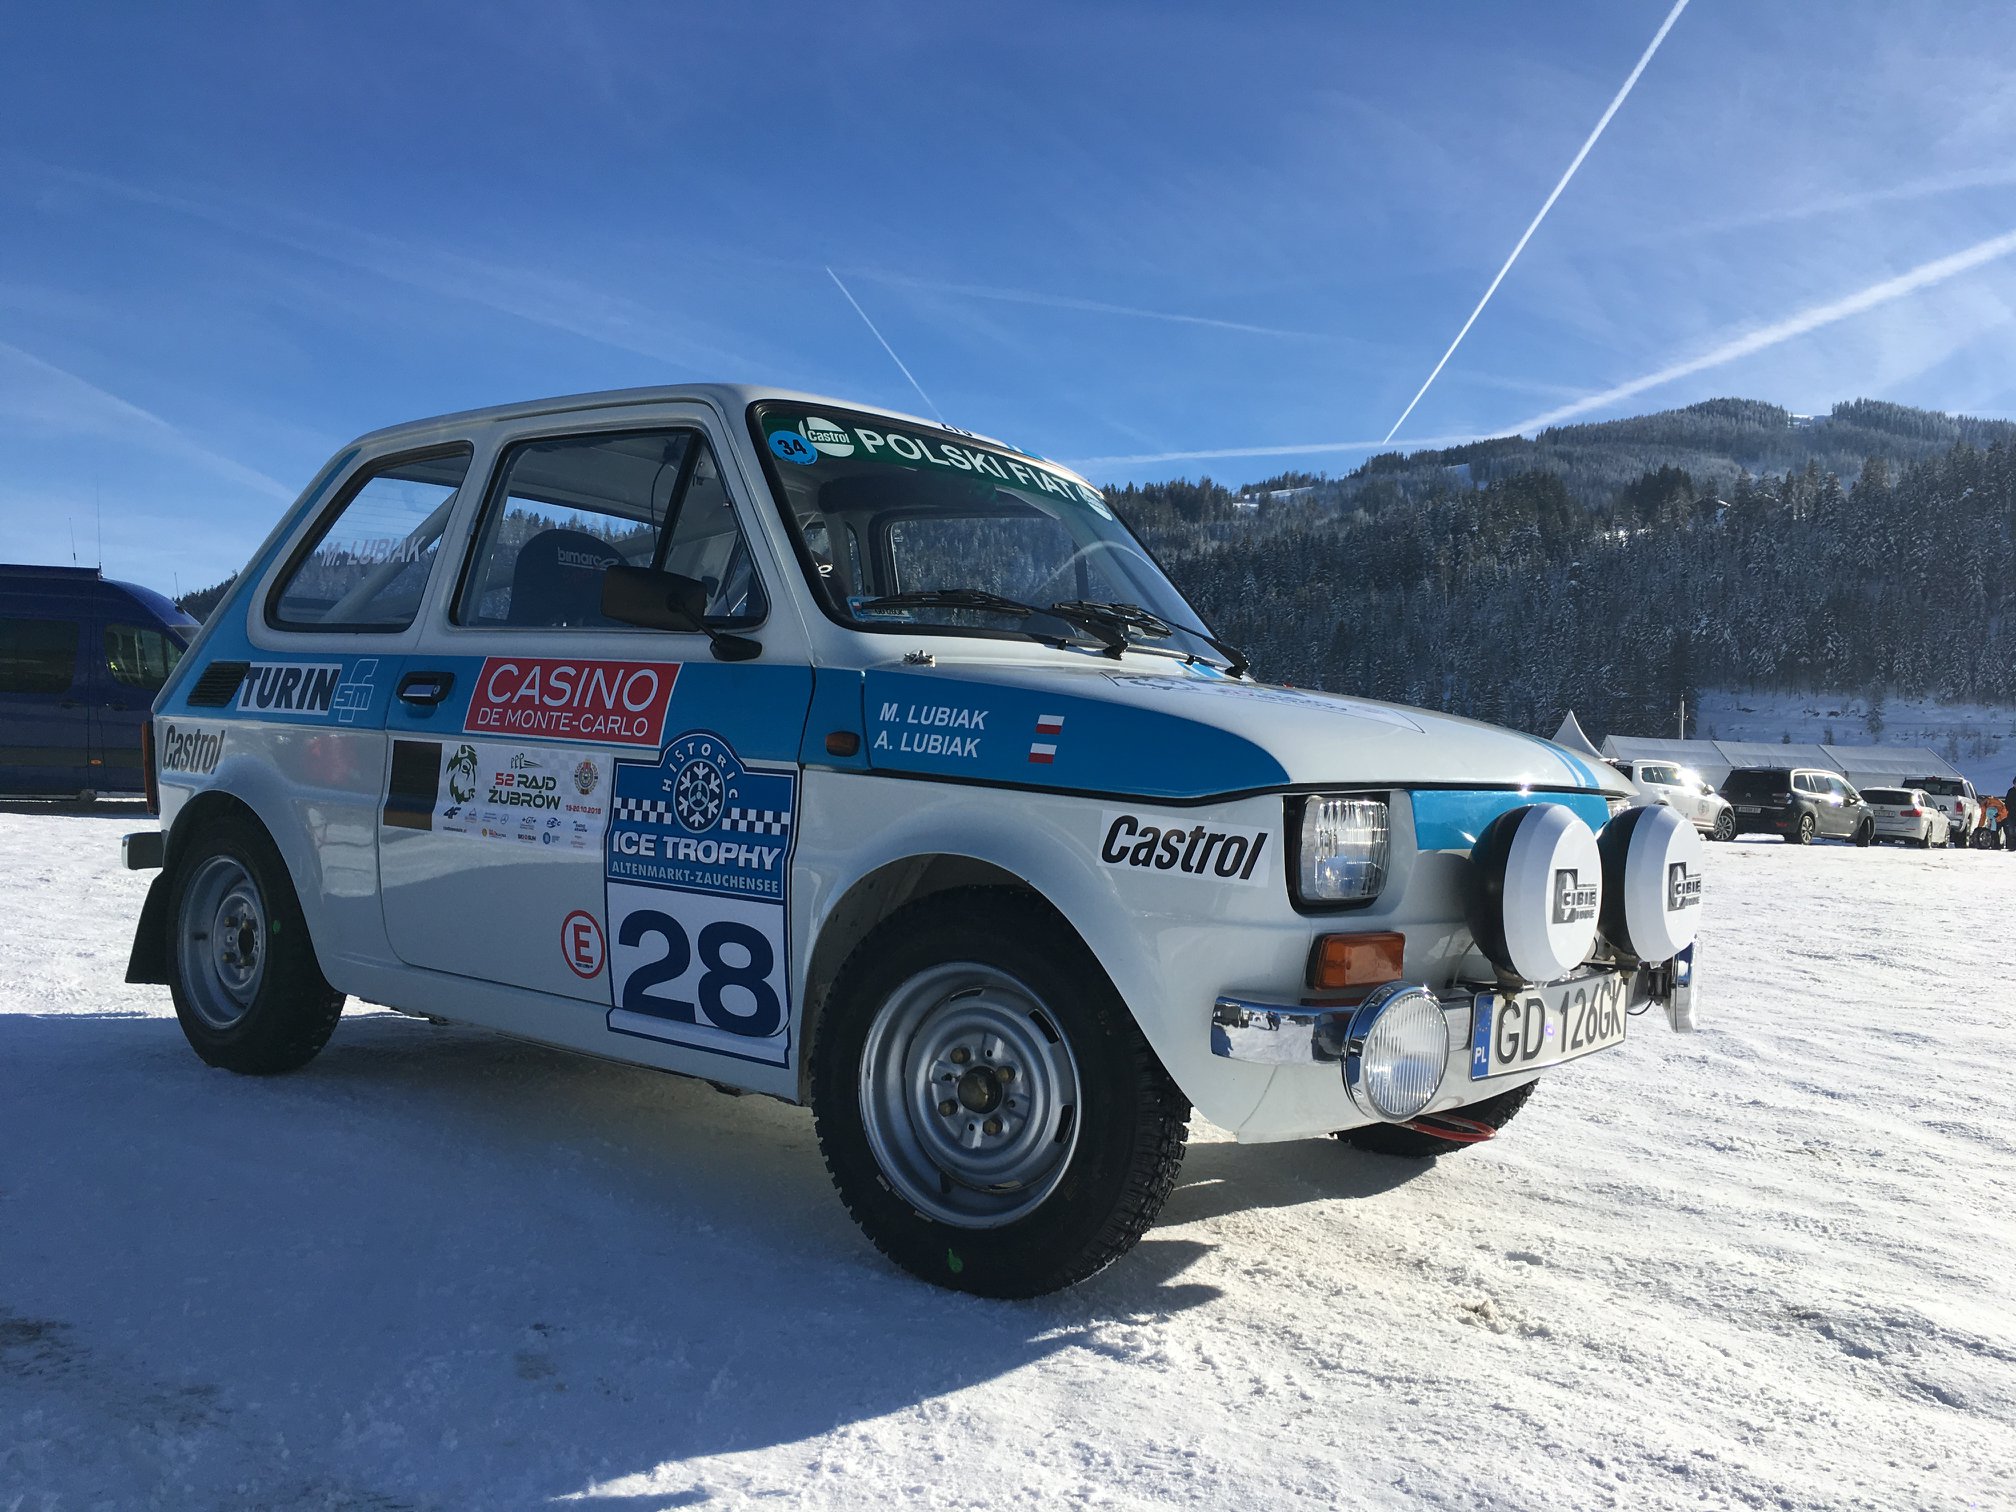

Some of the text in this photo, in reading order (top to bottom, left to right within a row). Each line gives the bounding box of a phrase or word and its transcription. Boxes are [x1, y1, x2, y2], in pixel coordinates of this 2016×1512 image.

[777, 439, 807, 456] 34
[806, 430, 851, 444] Castrol
[854, 427, 1078, 502] POLSKI FIAT
[320, 535, 427, 566] M. LUBIAK
[241, 666, 341, 712] TURIN
[487, 663, 659, 712] CASINO
[477, 707, 649, 737] DE MONTE-CARLO
[879, 702, 989, 730] M. LUBIAK
[162, 725, 226, 775] Castrol
[874, 730, 982, 758] A. LUBIAK
[495, 772, 515, 787] 52
[517, 773, 557, 791] RAJD
[662, 743, 739, 799] HISTORIC
[487, 786, 562, 811] ŻUBRÓW
[612, 831, 657, 857] ICE
[663, 835, 782, 871] TROPHY
[1101, 815, 1268, 880] Castrol
[612, 860, 779, 893] ALTENMARKT-ZAUCHENSEE
[1675, 879, 1701, 895] CIBIE
[1562, 889, 1596, 906] CIBIE
[573, 922, 594, 965] E
[618, 909, 782, 1038] 28
[1496, 978, 1624, 1066] GD 126GK
[1475, 1046, 1487, 1064] PL
